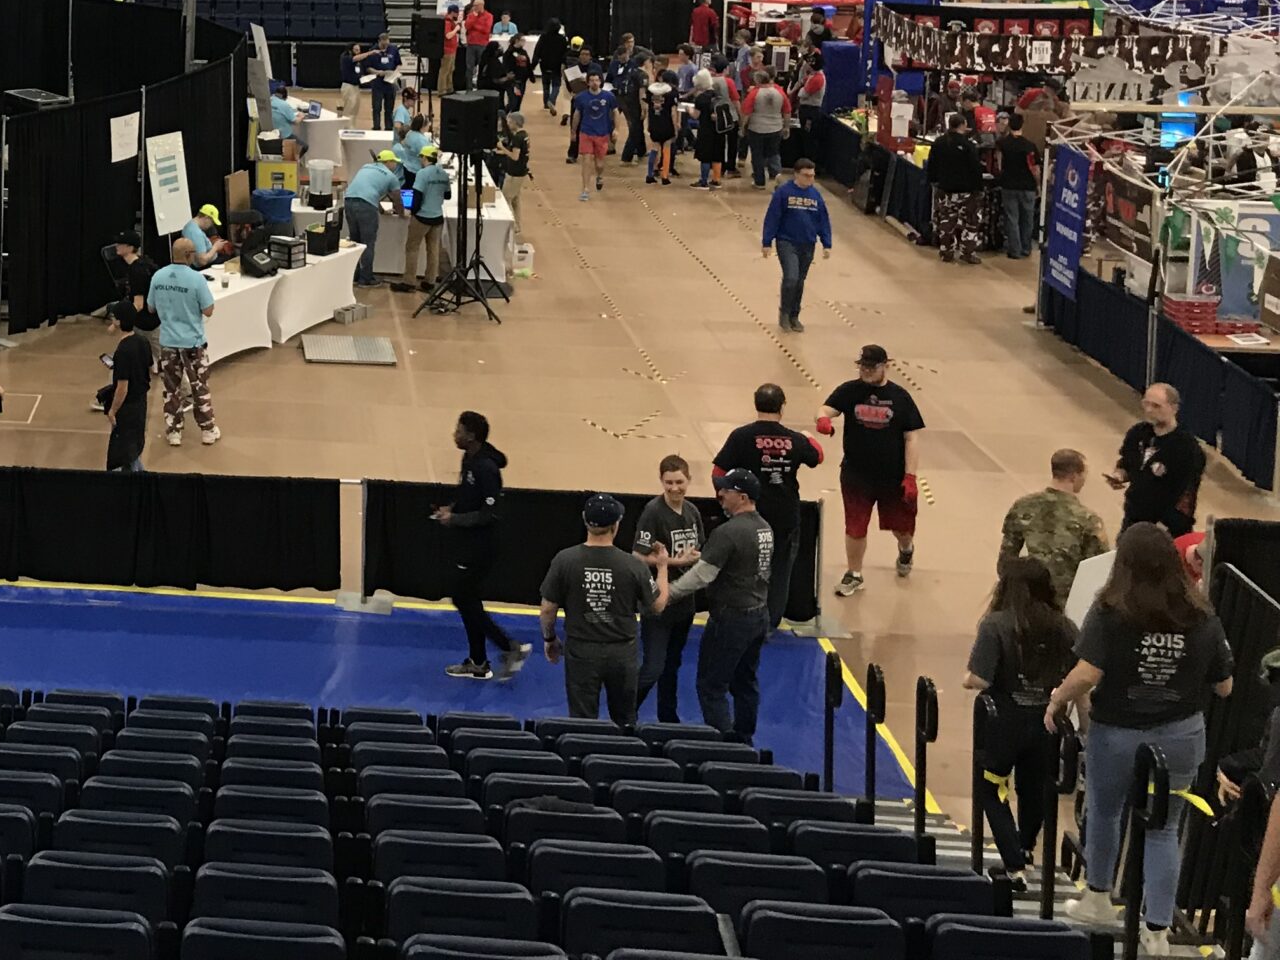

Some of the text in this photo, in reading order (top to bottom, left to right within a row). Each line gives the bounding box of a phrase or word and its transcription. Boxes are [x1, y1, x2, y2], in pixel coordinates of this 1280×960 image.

[640, 530, 651, 540] 10
[584, 571, 613, 583] 3015
[1141, 632, 1184, 648] 3015
